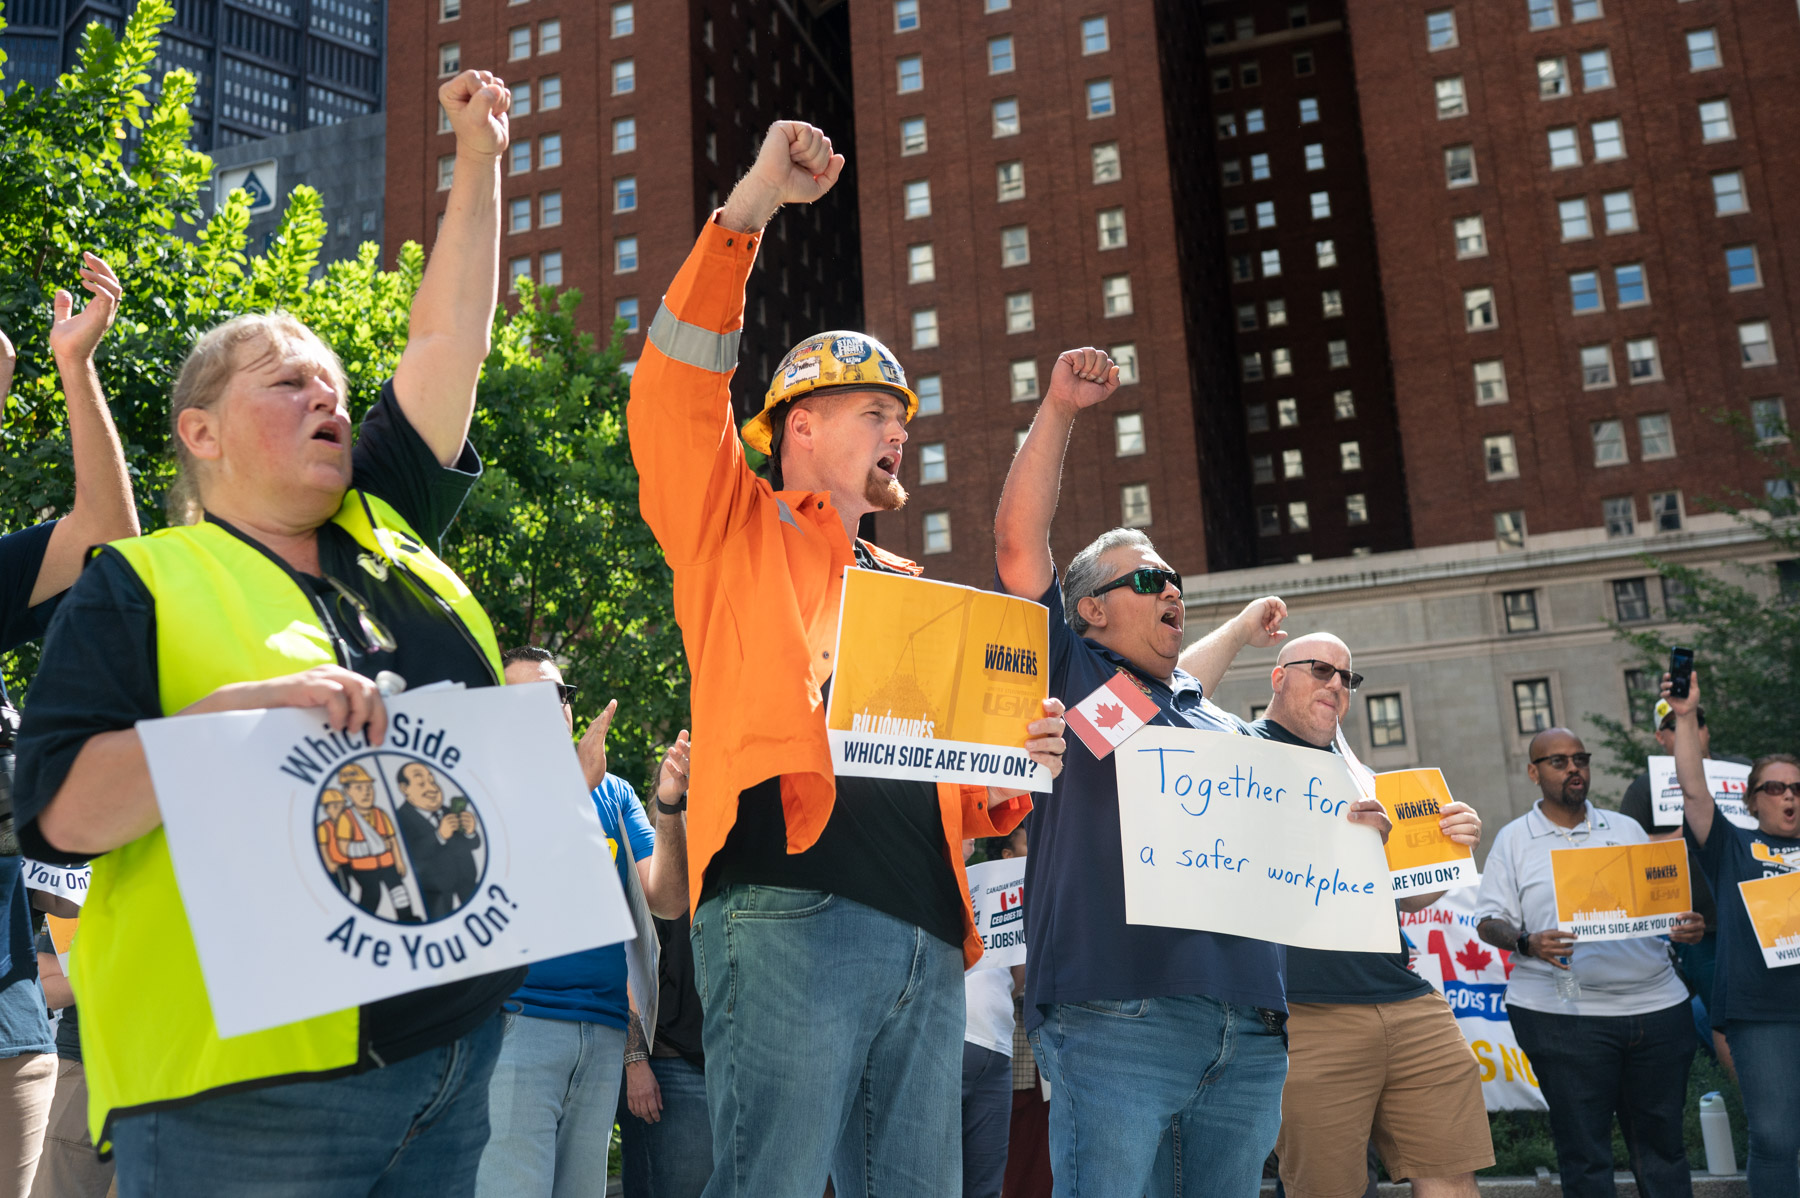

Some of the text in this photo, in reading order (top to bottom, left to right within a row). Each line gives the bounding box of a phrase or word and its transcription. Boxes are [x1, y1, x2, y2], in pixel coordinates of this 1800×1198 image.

[984, 644, 1038, 677] WORKERS
[851, 707, 935, 739] BILLIONAIRES
[390, 713, 461, 769] Side
[844, 741, 1038, 778] WHICH SIDE ARE YOU ON?
[1137, 747, 1348, 817] Together for
[1394, 798, 1440, 820] WORKERS
[28, 862, 60, 888] You
[1140, 838, 1374, 906] a safer workplace
[1409, 870, 1433, 887] YOU
[1435, 866, 1460, 883] ON?
[1645, 864, 1678, 881] WORKERS
[986, 883, 1009, 895] CANADIAN
[1009, 878, 1024, 888] WORKE
[326, 884, 518, 970] Are You On?
[1400, 908, 1454, 928] ADIAN
[1571, 917, 1687, 937] WHICH SIDE ARE YOU ON
[989, 931, 1015, 950] JOBS
[1015, 929, 1026, 946] NO
[1775, 947, 1800, 961] WHIC
[1446, 988, 1486, 1011] GOES
[1498, 1043, 1540, 1088] NO
